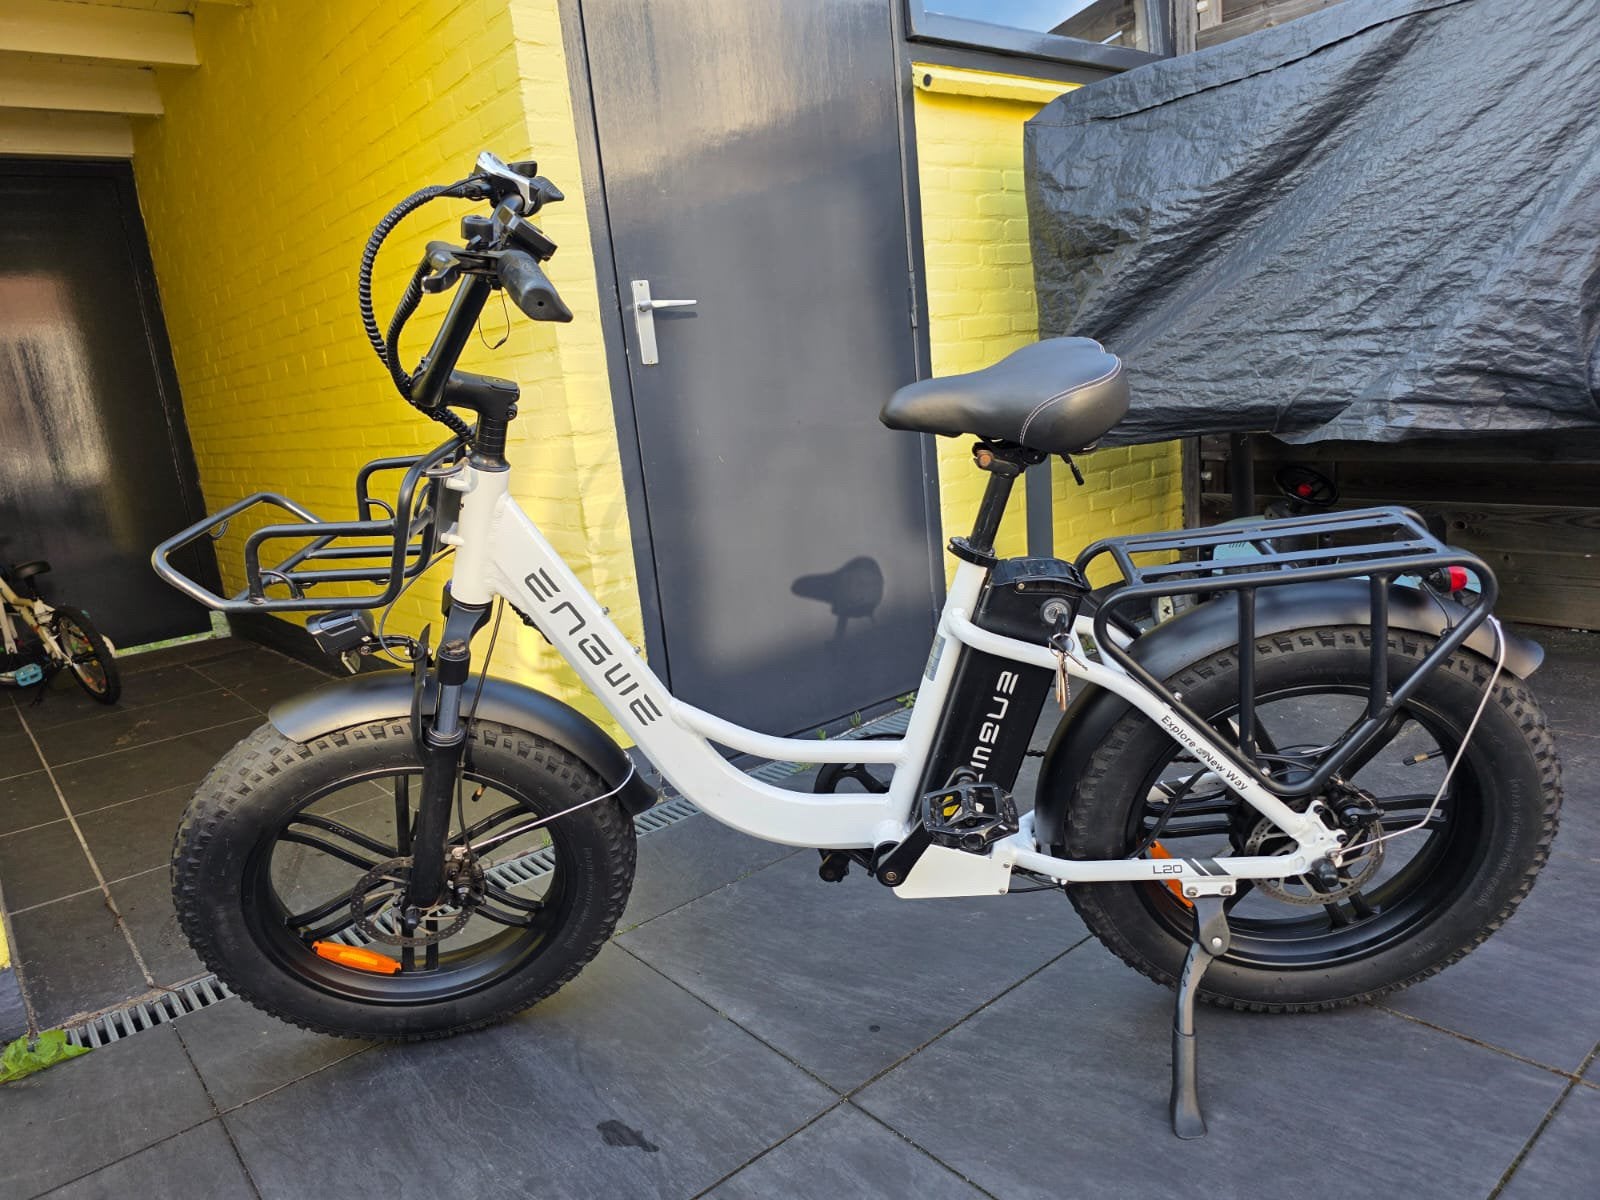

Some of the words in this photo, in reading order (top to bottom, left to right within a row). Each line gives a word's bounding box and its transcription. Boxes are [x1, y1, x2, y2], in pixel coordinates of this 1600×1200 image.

[524, 567, 663, 726] ENGWE
[970, 671, 1019, 782] ENGW
[1161, 715, 1196, 748] Explore
[1204, 753, 1225, 772] New
[1226, 770, 1248, 791] Way
[1152, 864, 1183, 874] L20
